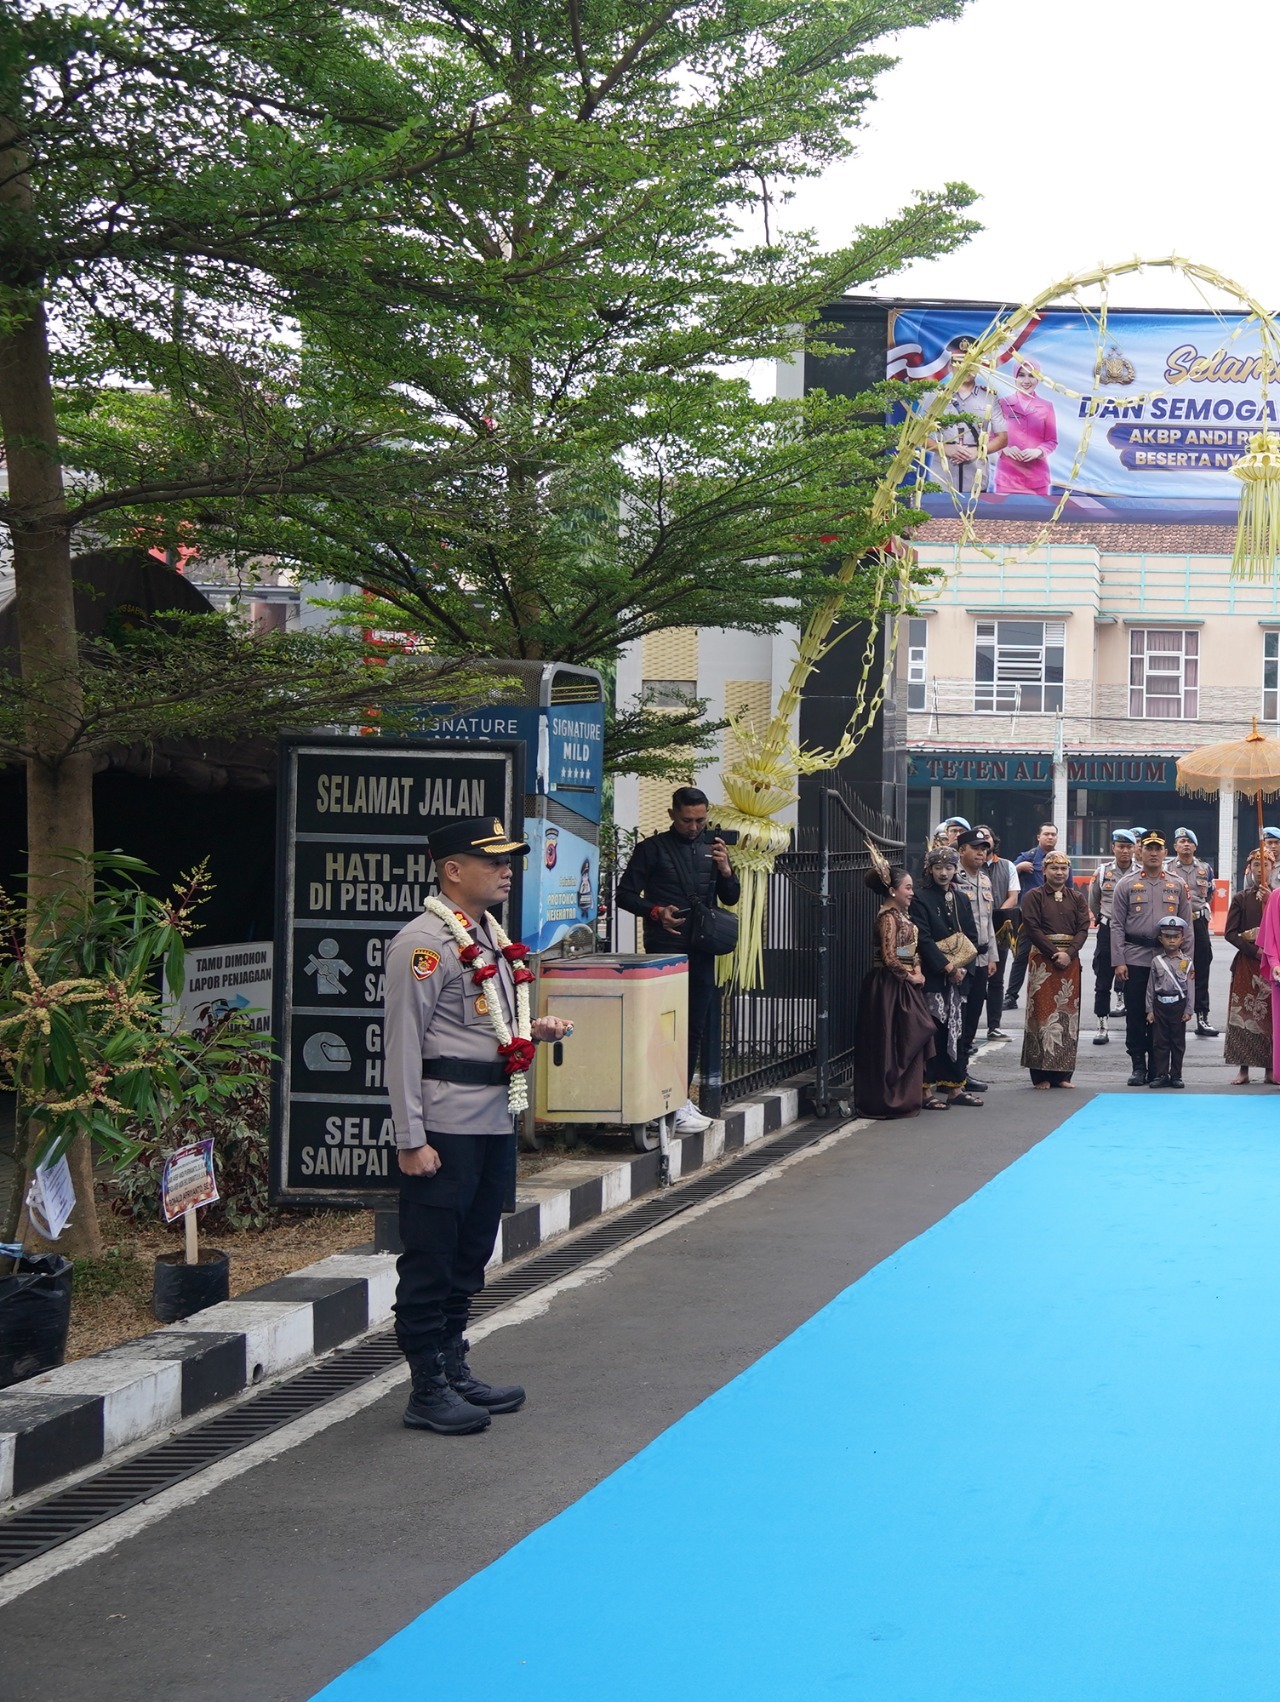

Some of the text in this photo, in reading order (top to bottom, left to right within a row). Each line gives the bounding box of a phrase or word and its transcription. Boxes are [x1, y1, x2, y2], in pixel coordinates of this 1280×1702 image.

[1079, 396, 1145, 419] DAN
[1151, 398, 1277, 421] SEMOGA
[1129, 429, 1181, 444] AKBP
[1185, 430, 1233, 445] ANDI
[1135, 451, 1211, 467] BESERTA
[552, 717, 601, 741] SIGNATURE
[563, 743, 590, 761] MILD
[926, 759, 1168, 784] TETEN ALMINIUM
[316, 774, 485, 816] SELAMAT JALAN
[310, 882, 331, 910] DI
[196, 951, 267, 972] TAMU DIMOHON
[189, 968, 272, 992] LAPOR PENJAGAAN
[301, 1146, 388, 1177] SAMPAI
